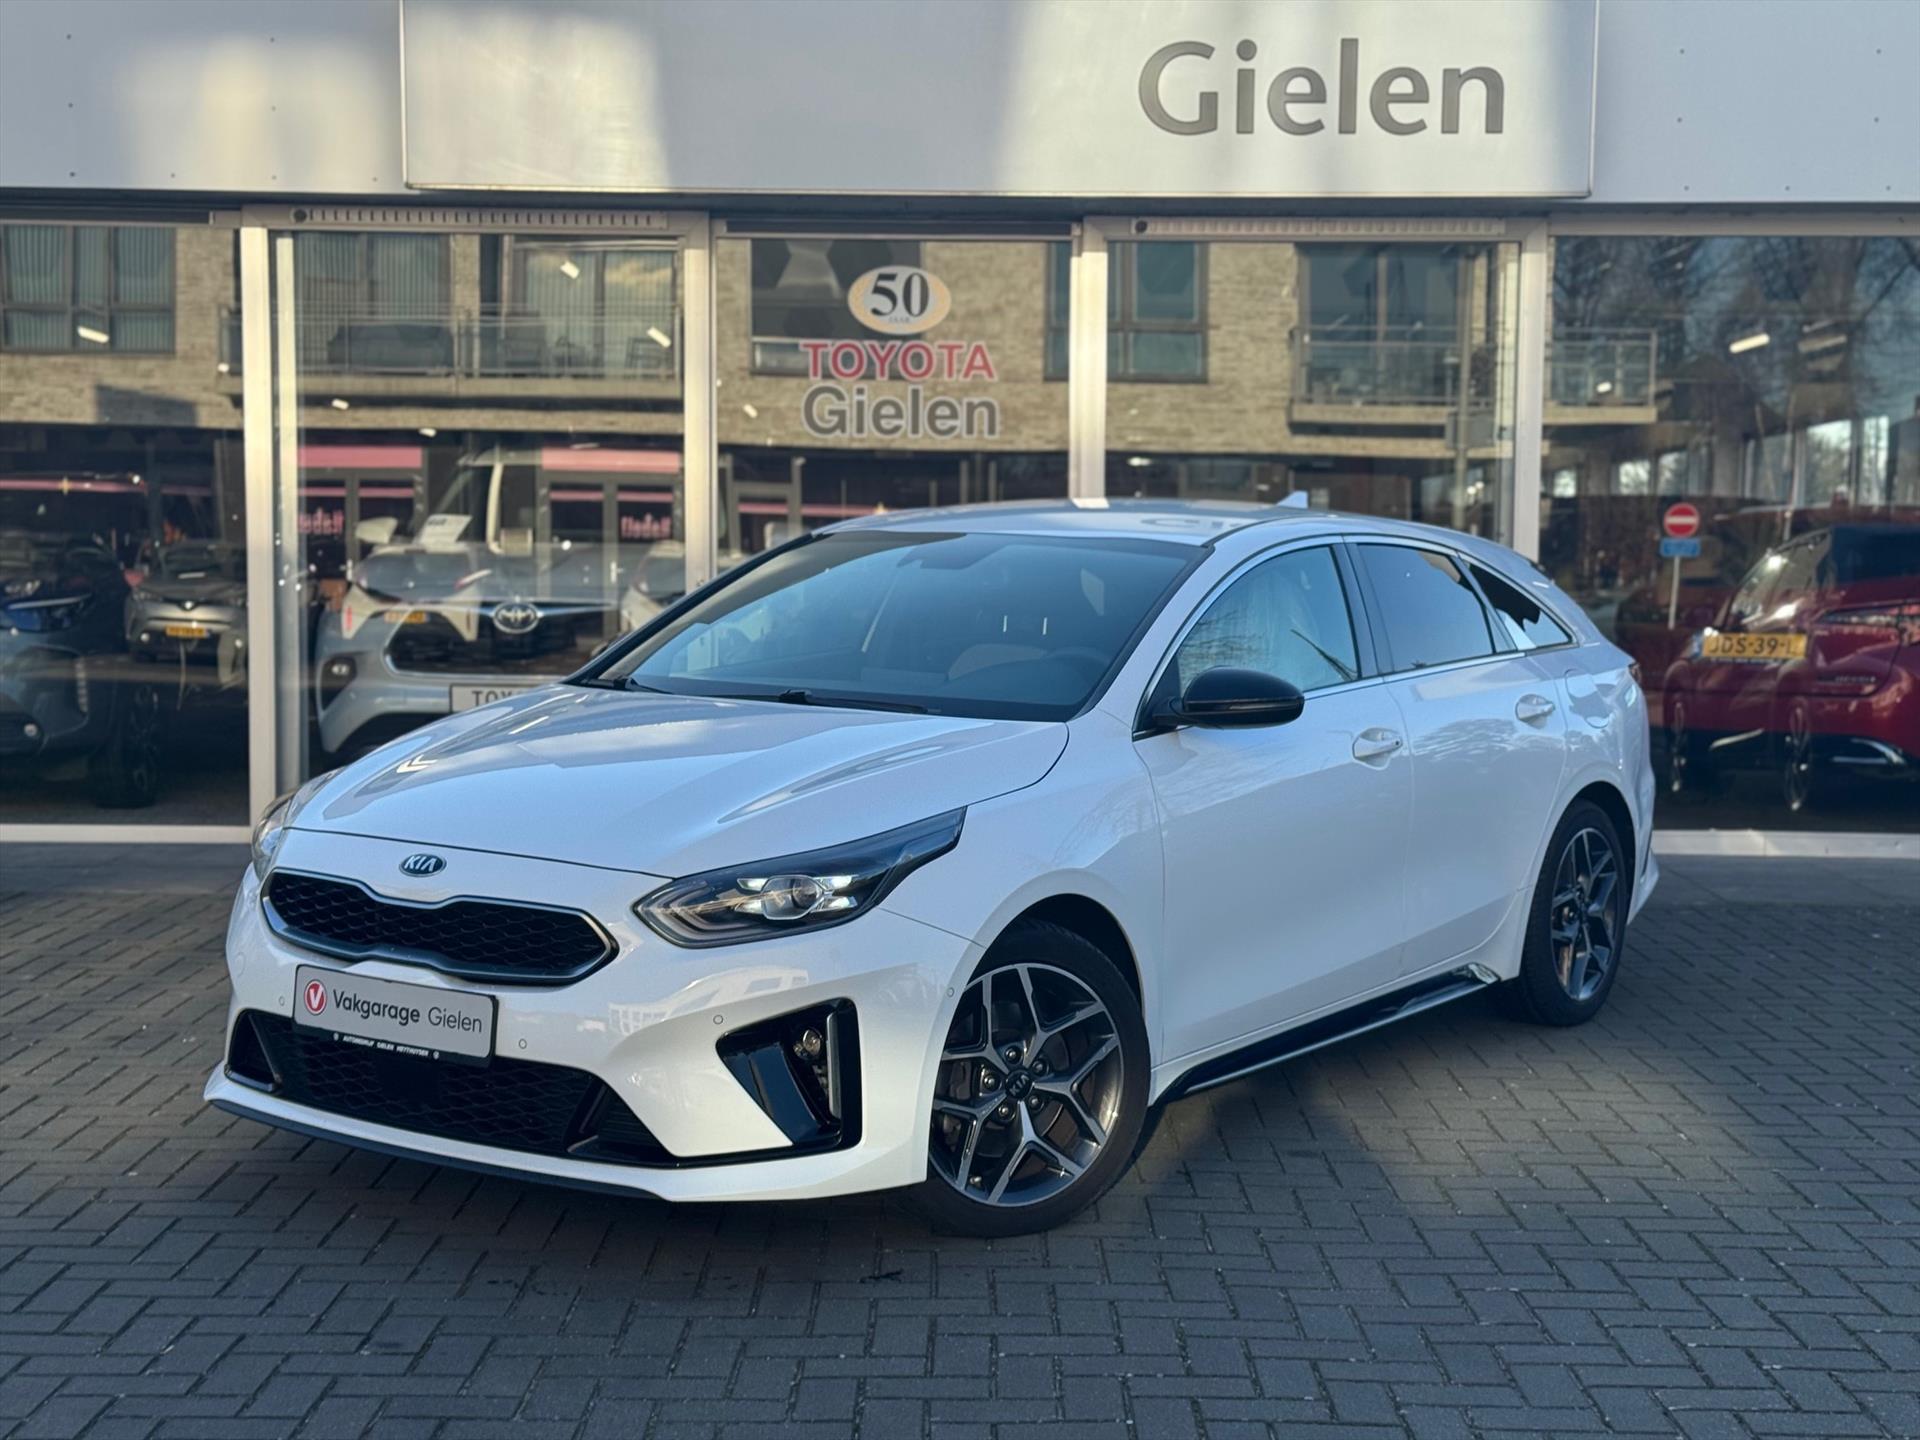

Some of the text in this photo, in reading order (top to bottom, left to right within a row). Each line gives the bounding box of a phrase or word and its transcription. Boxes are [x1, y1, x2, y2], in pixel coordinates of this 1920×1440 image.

[1138, 37, 1505, 137] Gielen
[870, 272, 930, 318] 50
[799, 340, 997, 380] TOYOTA
[802, 383, 998, 438] Gielen
[403, 855, 438, 872] KIA
[332, 989, 483, 1034] Vakgarage Gielen
[1009, 1074, 1030, 1097] KIA
